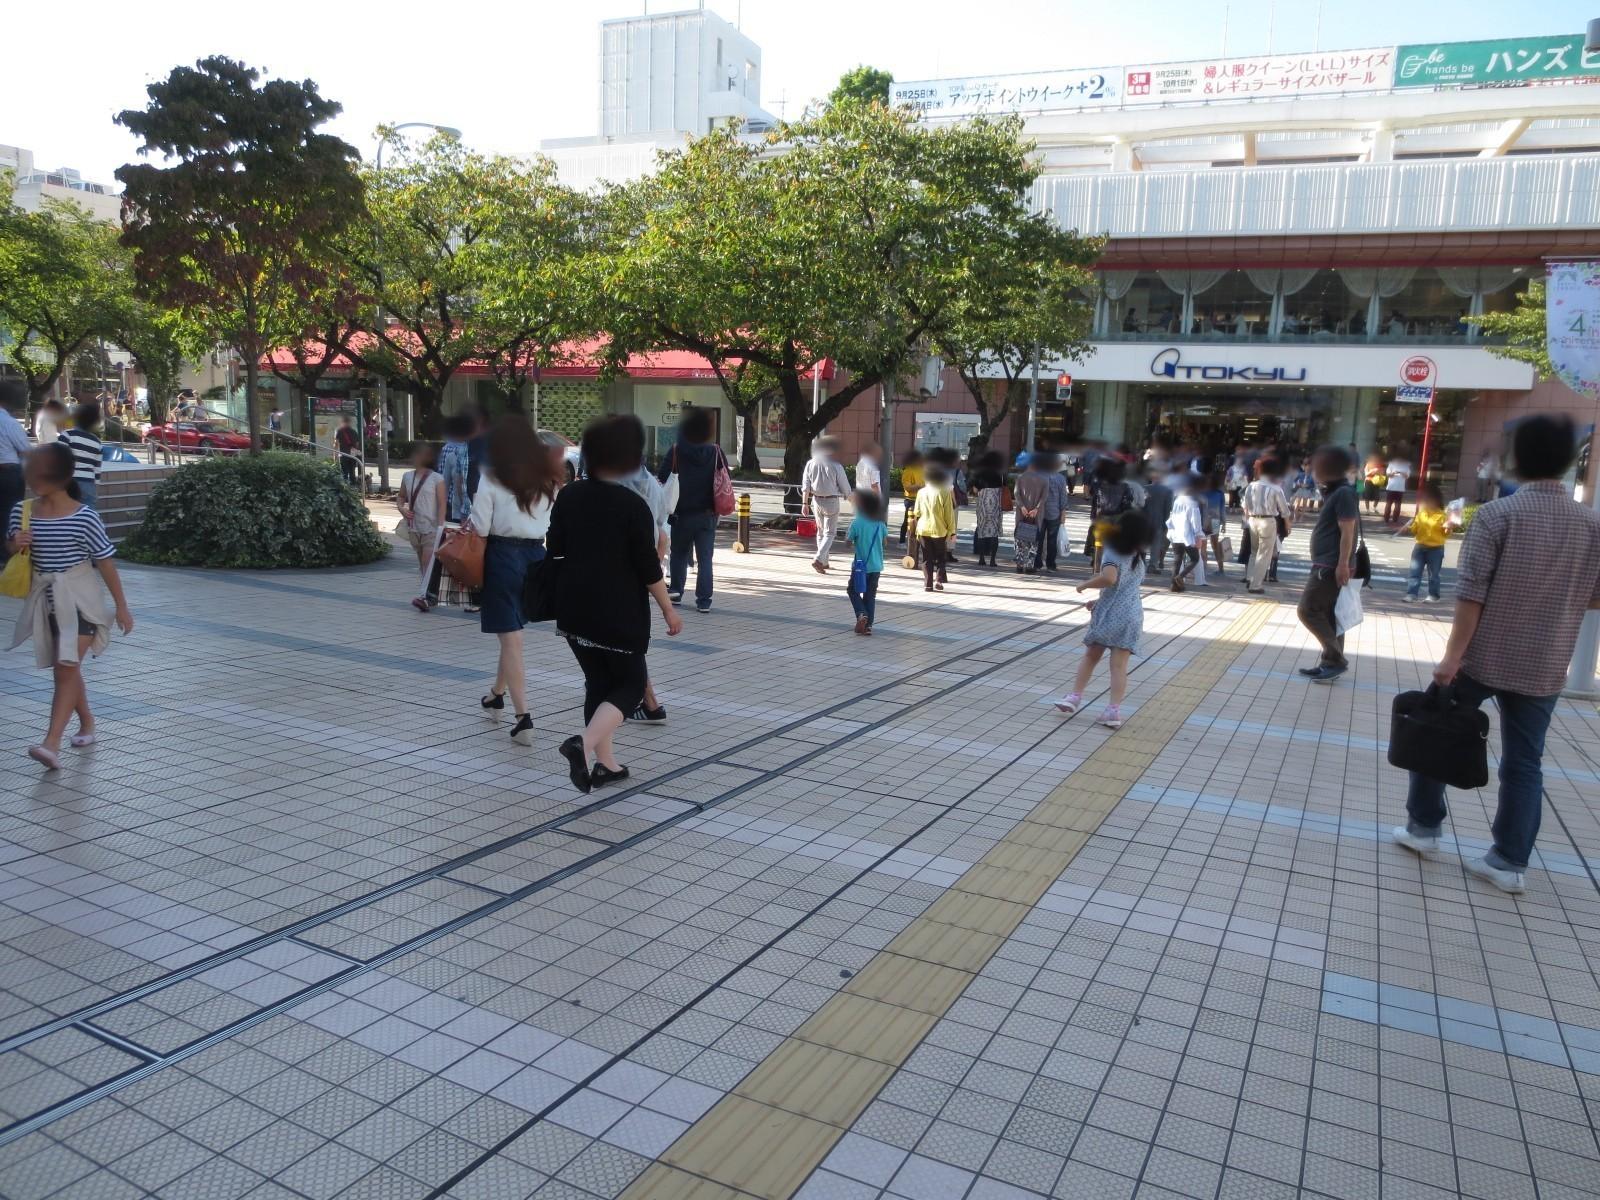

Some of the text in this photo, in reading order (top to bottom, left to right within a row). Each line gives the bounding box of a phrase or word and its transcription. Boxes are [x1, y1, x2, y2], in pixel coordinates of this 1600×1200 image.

[1425, 64, 1475, 75] hands be
[1203, 71, 1376, 94] &レギュラーサイズバザール
[896, 89, 937, 99] 9月25日(木)
[1177, 365, 1306, 381] TOKYU
